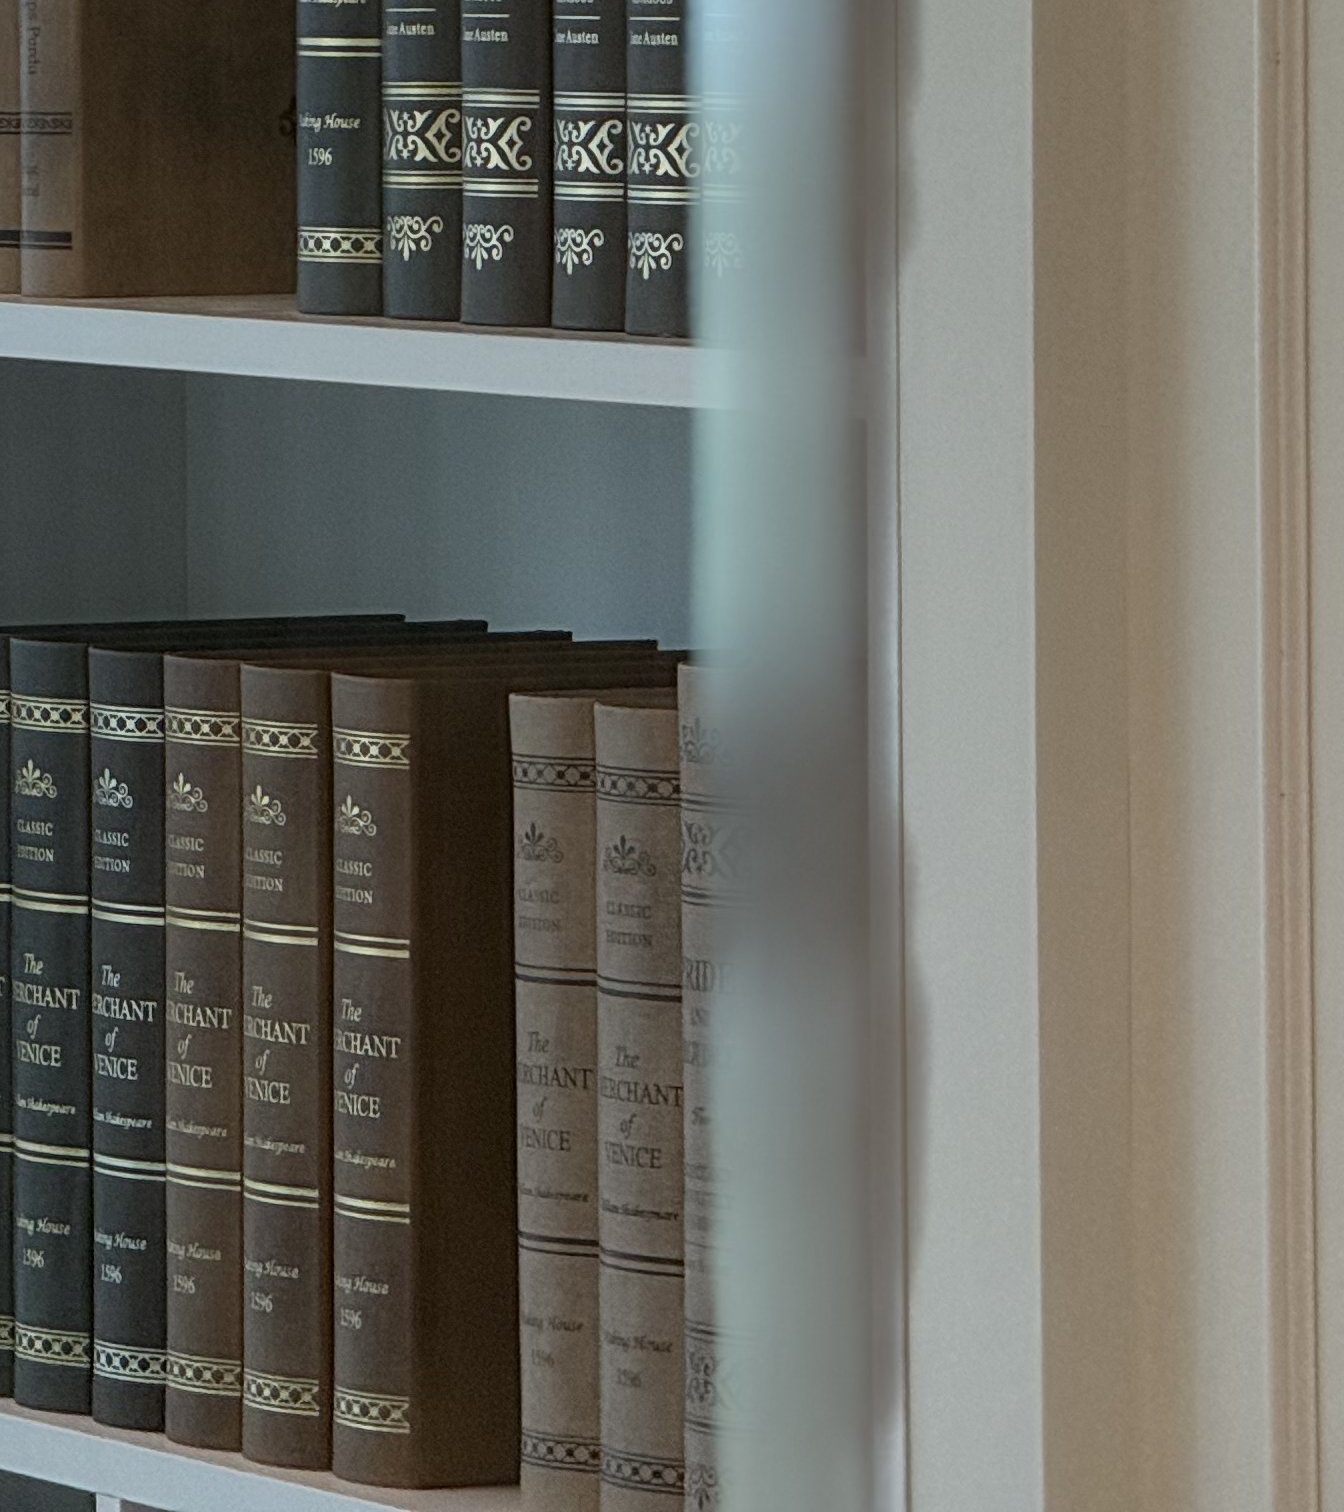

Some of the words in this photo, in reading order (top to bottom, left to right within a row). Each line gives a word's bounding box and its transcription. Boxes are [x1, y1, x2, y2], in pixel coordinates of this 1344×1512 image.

[399, 22, 435, 35] Austen
[474, 28, 508, 42] Austen
[566, 30, 599, 44] Austen
[643, 31, 678, 46] Austen
[323, 114, 361, 130] House
[308, 147, 333, 166] 1596
[101, 965, 120, 988] The
[341, 999, 362, 1022] The
[105, 1027, 118, 1052] of
[344, 1063, 359, 1089] of
[113, 1232, 147, 1251] House
[101, 1264, 122, 1284] 1596
[353, 1275, 389, 1295] House
[340, 1309, 362, 1330] 1596
